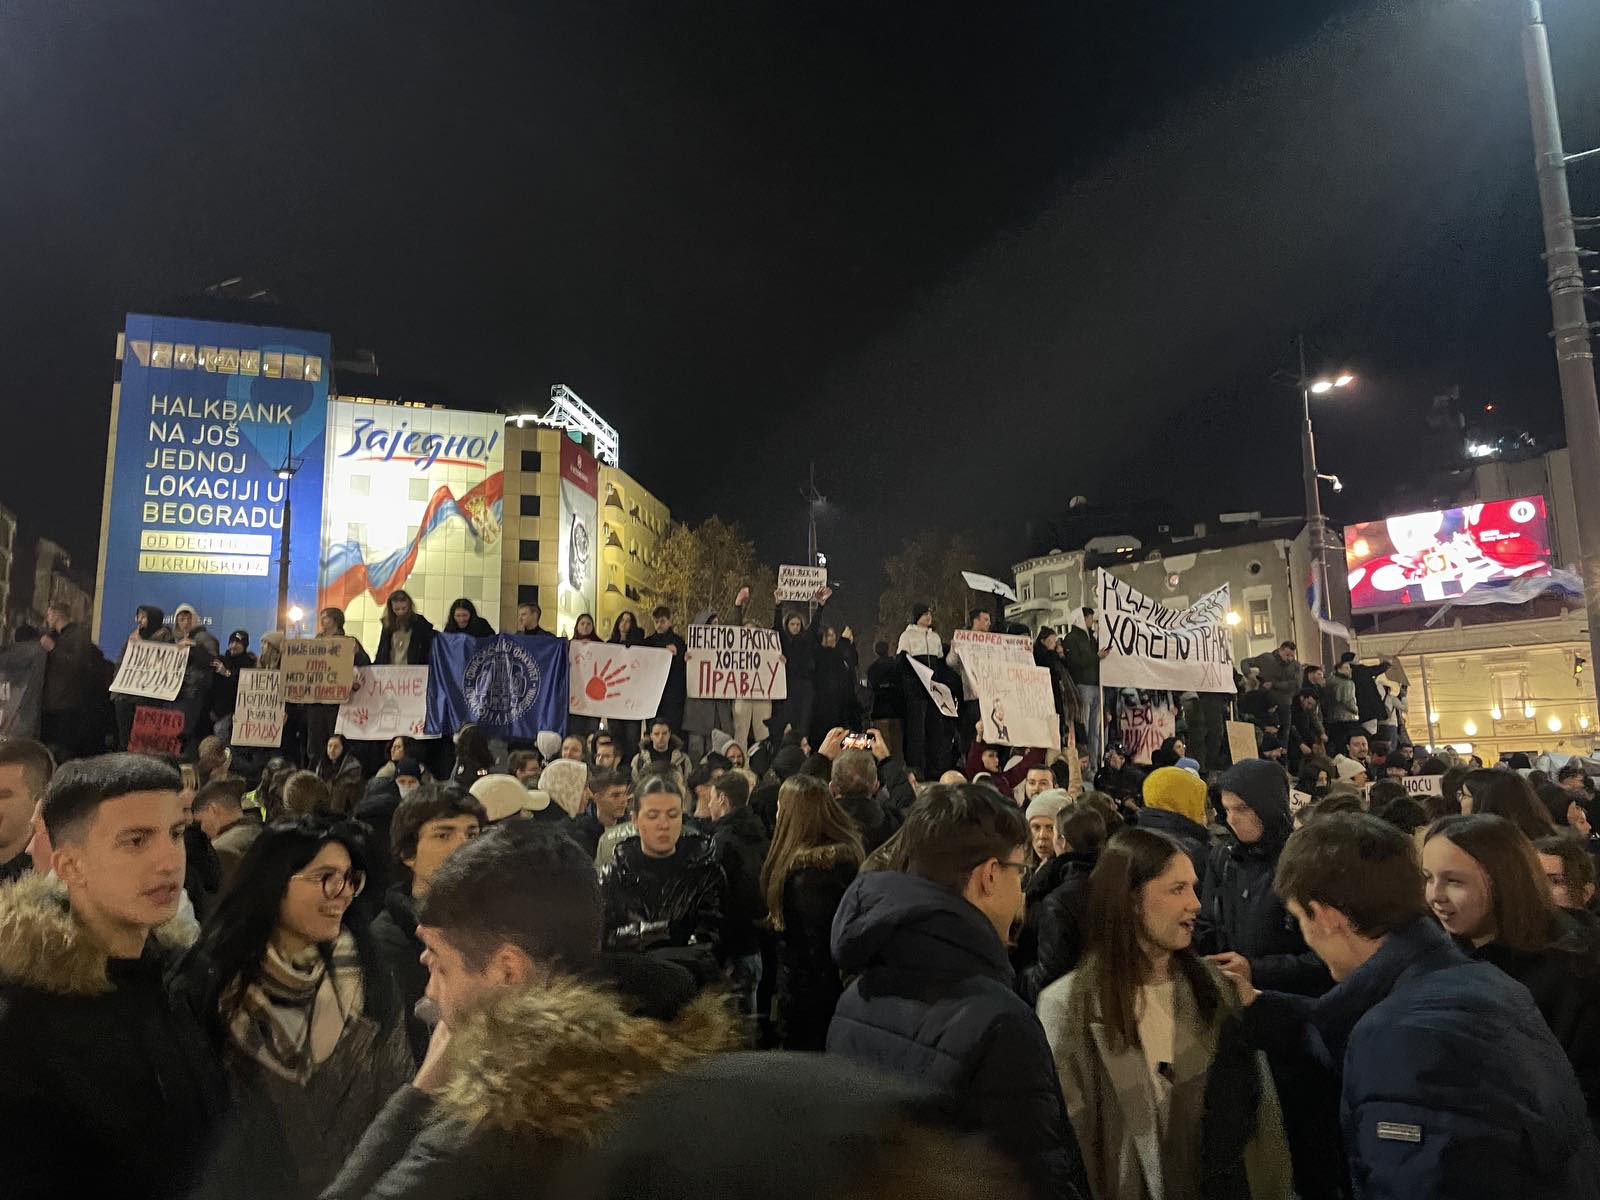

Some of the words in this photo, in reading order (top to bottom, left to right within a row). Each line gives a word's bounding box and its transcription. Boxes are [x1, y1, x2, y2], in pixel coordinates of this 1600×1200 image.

[151, 395, 292, 424] HALKBANK
[149, 421, 185, 444] NA
[192, 423, 239, 447] JOŠ
[145, 448, 246, 474] JEDNOJ
[144, 475, 258, 501] LOKACIJI
[267, 481, 285, 503] U
[142, 502, 284, 529] BEOGRADU
[146, 534, 169, 549] OD
[144, 556, 156, 570] U
[688, 624, 735, 650] НЕЋЕМО
[715, 650, 761, 672] ХОЋЕМО
[368, 679, 423, 697] ЛАЖЕ
[699, 660, 780, 697] ПРАВДУ
